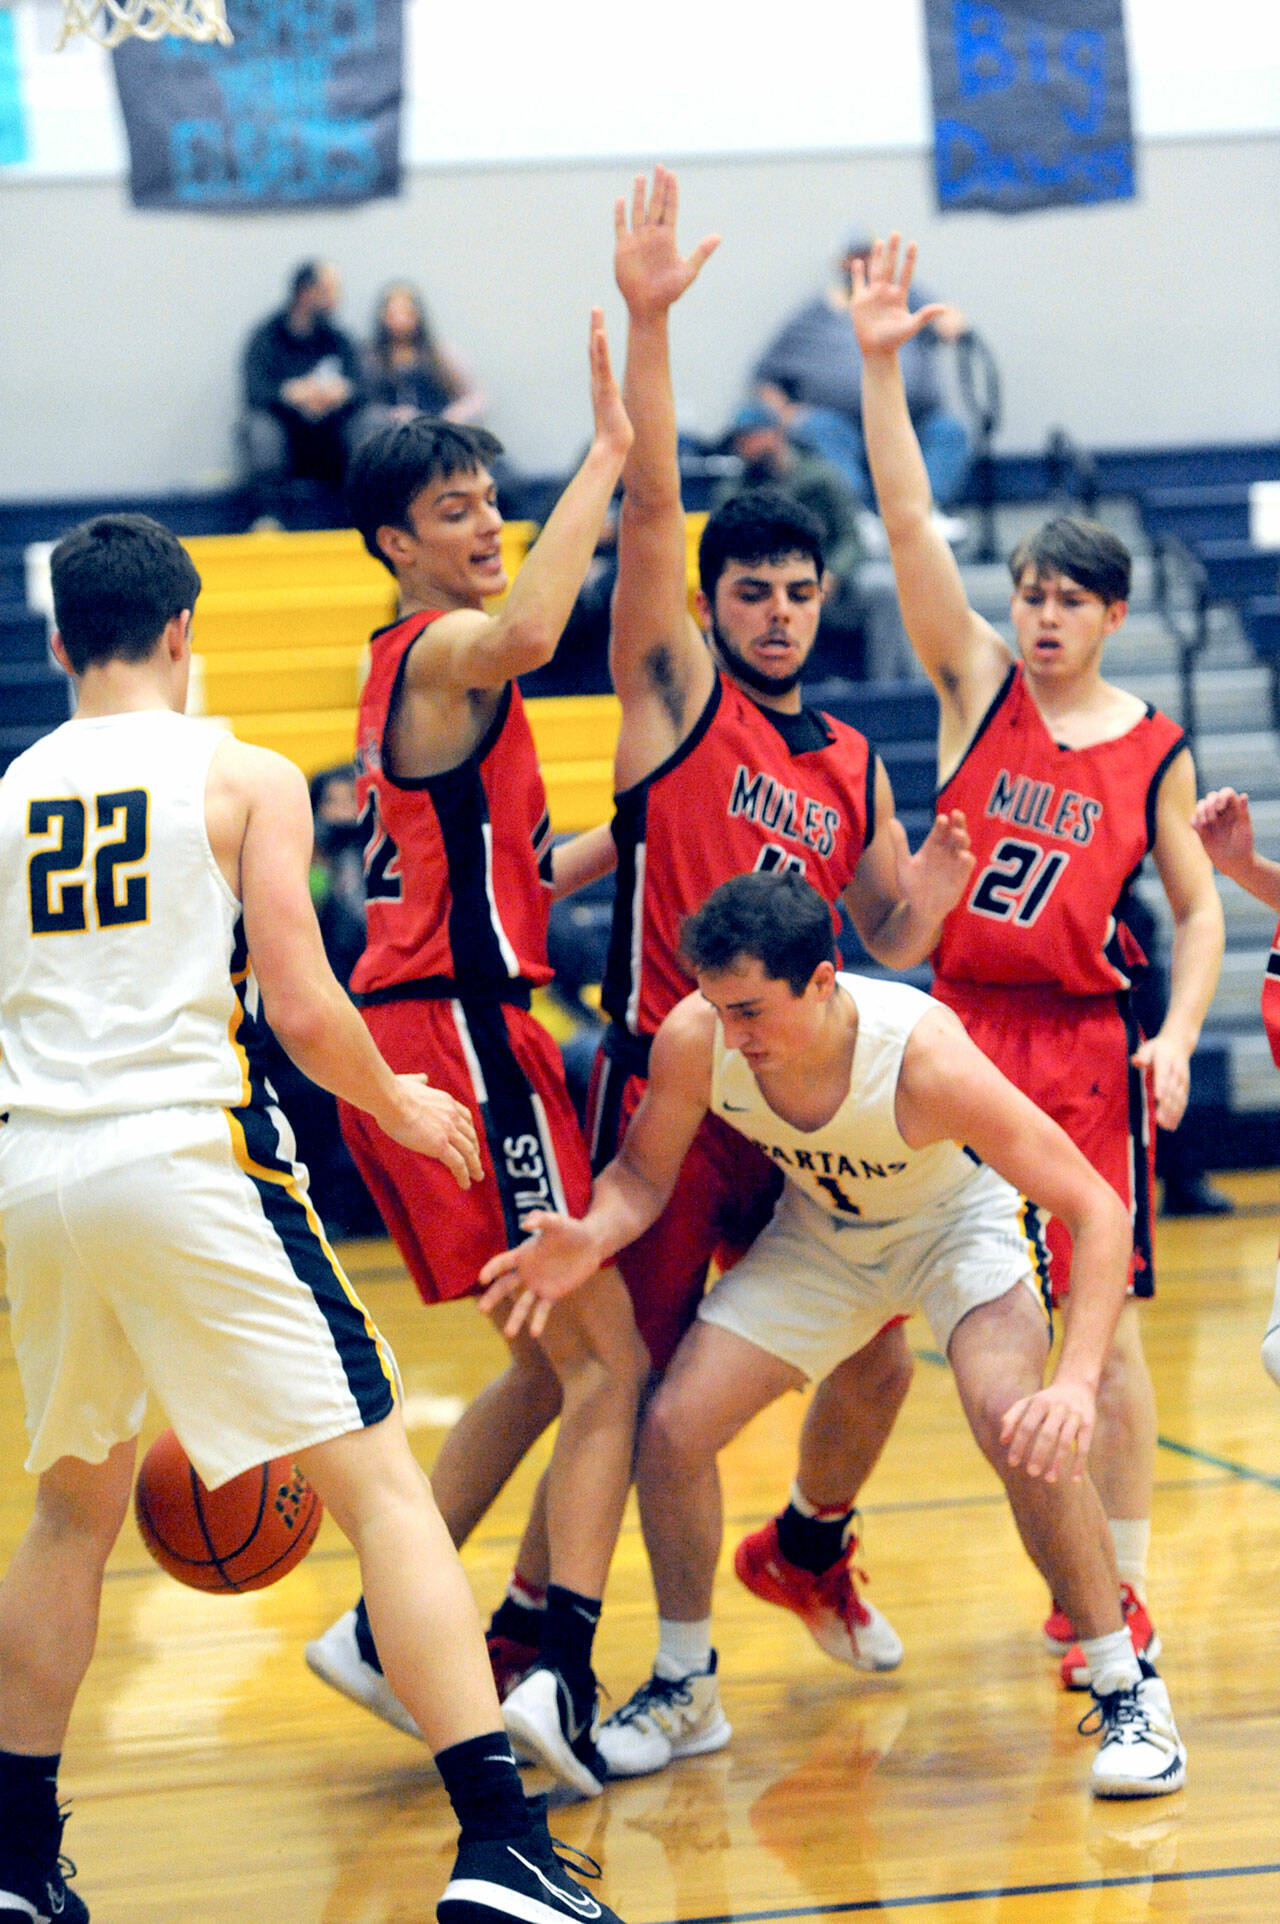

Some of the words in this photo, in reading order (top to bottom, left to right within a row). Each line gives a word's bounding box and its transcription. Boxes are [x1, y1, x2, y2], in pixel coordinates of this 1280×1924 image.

[953, 0, 1107, 135] Big
[727, 764, 841, 860] MULES
[985, 768, 1103, 848] MULES
[27, 785, 151, 938] 22
[967, 837, 1071, 928] 21
[503, 1133, 554, 1234] ULES
[815, 1175, 863, 1216] 1
